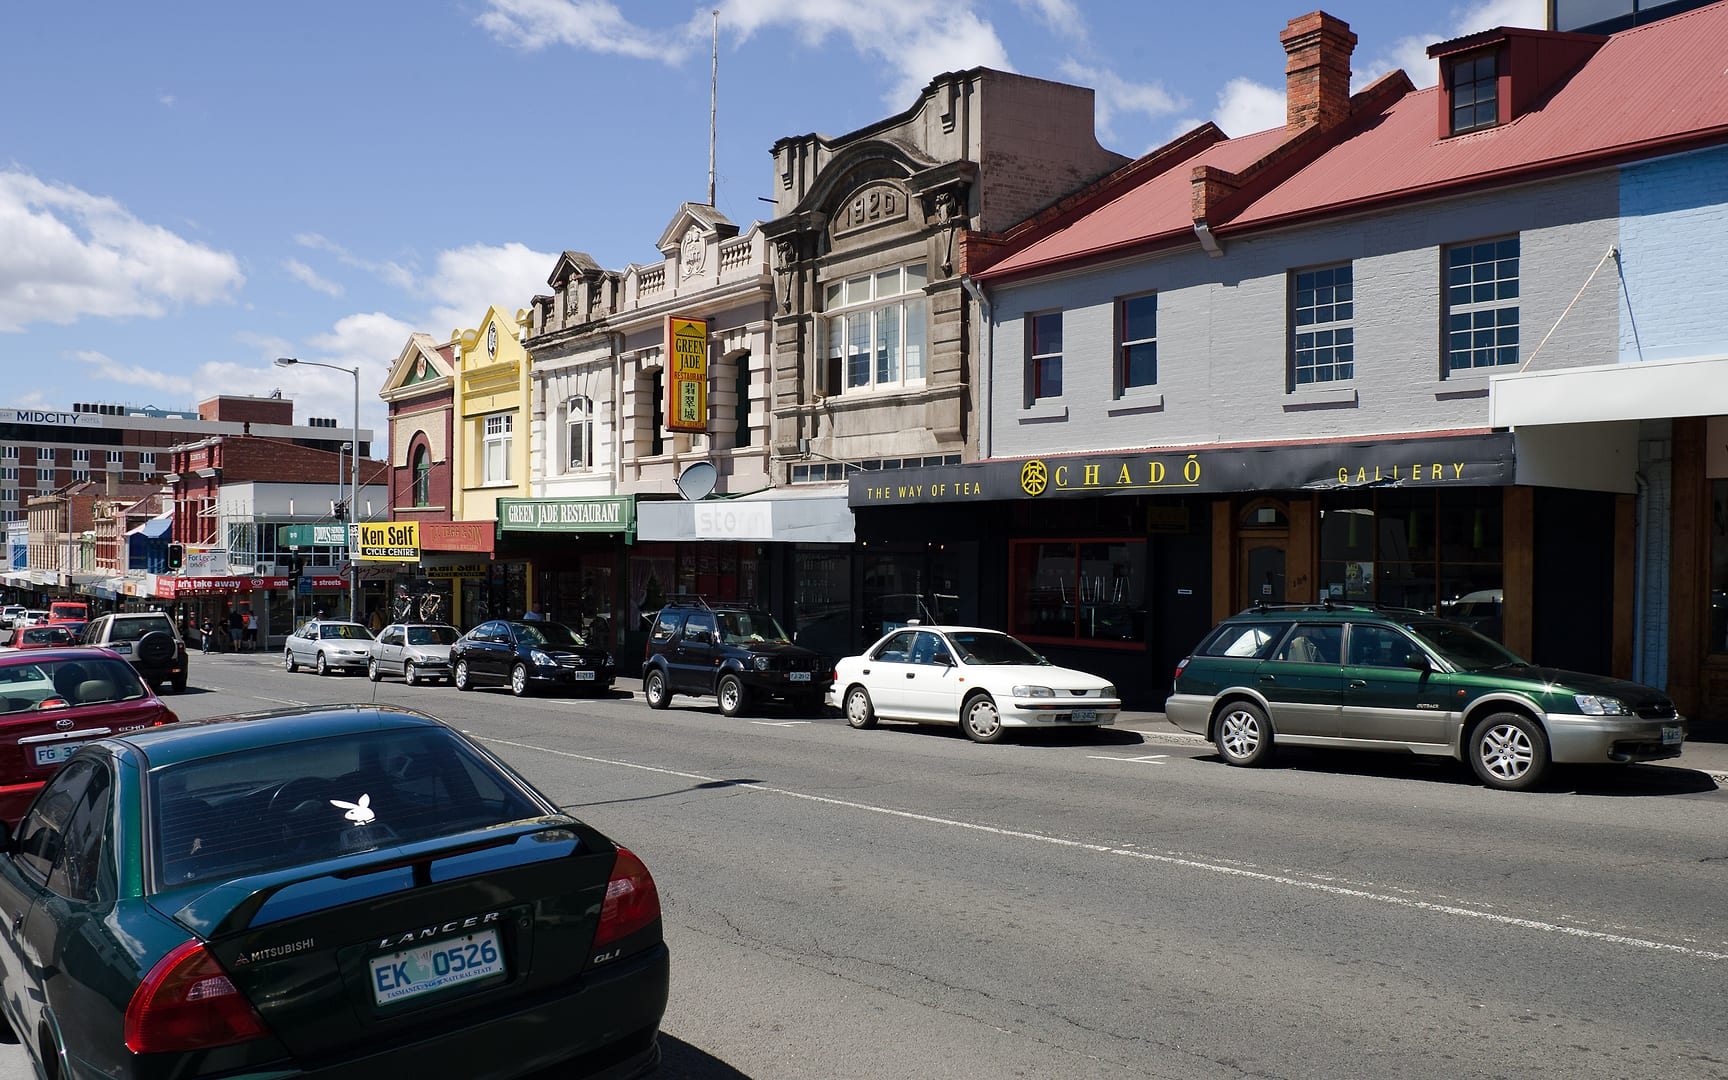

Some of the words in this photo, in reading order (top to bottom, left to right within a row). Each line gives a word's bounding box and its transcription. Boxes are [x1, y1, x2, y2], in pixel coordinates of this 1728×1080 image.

[847, 191, 895, 227] 1920
[675, 338, 704, 354] GREEN
[680, 354, 700, 371] JADE
[674, 371, 706, 382] RESTAURANT
[17, 411, 80, 424] MIDCITY
[1338, 462, 1465, 483] GALLERY
[867, 487, 890, 499] THE
[898, 485, 923, 498] WAY
[931, 484, 946, 497] OF
[954, 481, 981, 496] TEA
[508, 504, 534, 522] GREEN
[537, 504, 558, 528] JADE
[560, 503, 621, 522] RESTAURANT
[362, 527, 384, 545] Ken
[388, 526, 414, 545] Self
[366, 548, 386, 556] CYCLE
[388, 548, 414, 556] CENTRE
[193, 579, 213, 588] take
[215, 580, 240, 588] away
[38, 749, 55, 760] FG
[378, 912, 499, 949] LANCER
[251, 937, 315, 962] MITSUBISHI
[375, 961, 411, 992] EK
[432, 939, 497, 976] 0526
[474, 966, 493, 975] STATE
